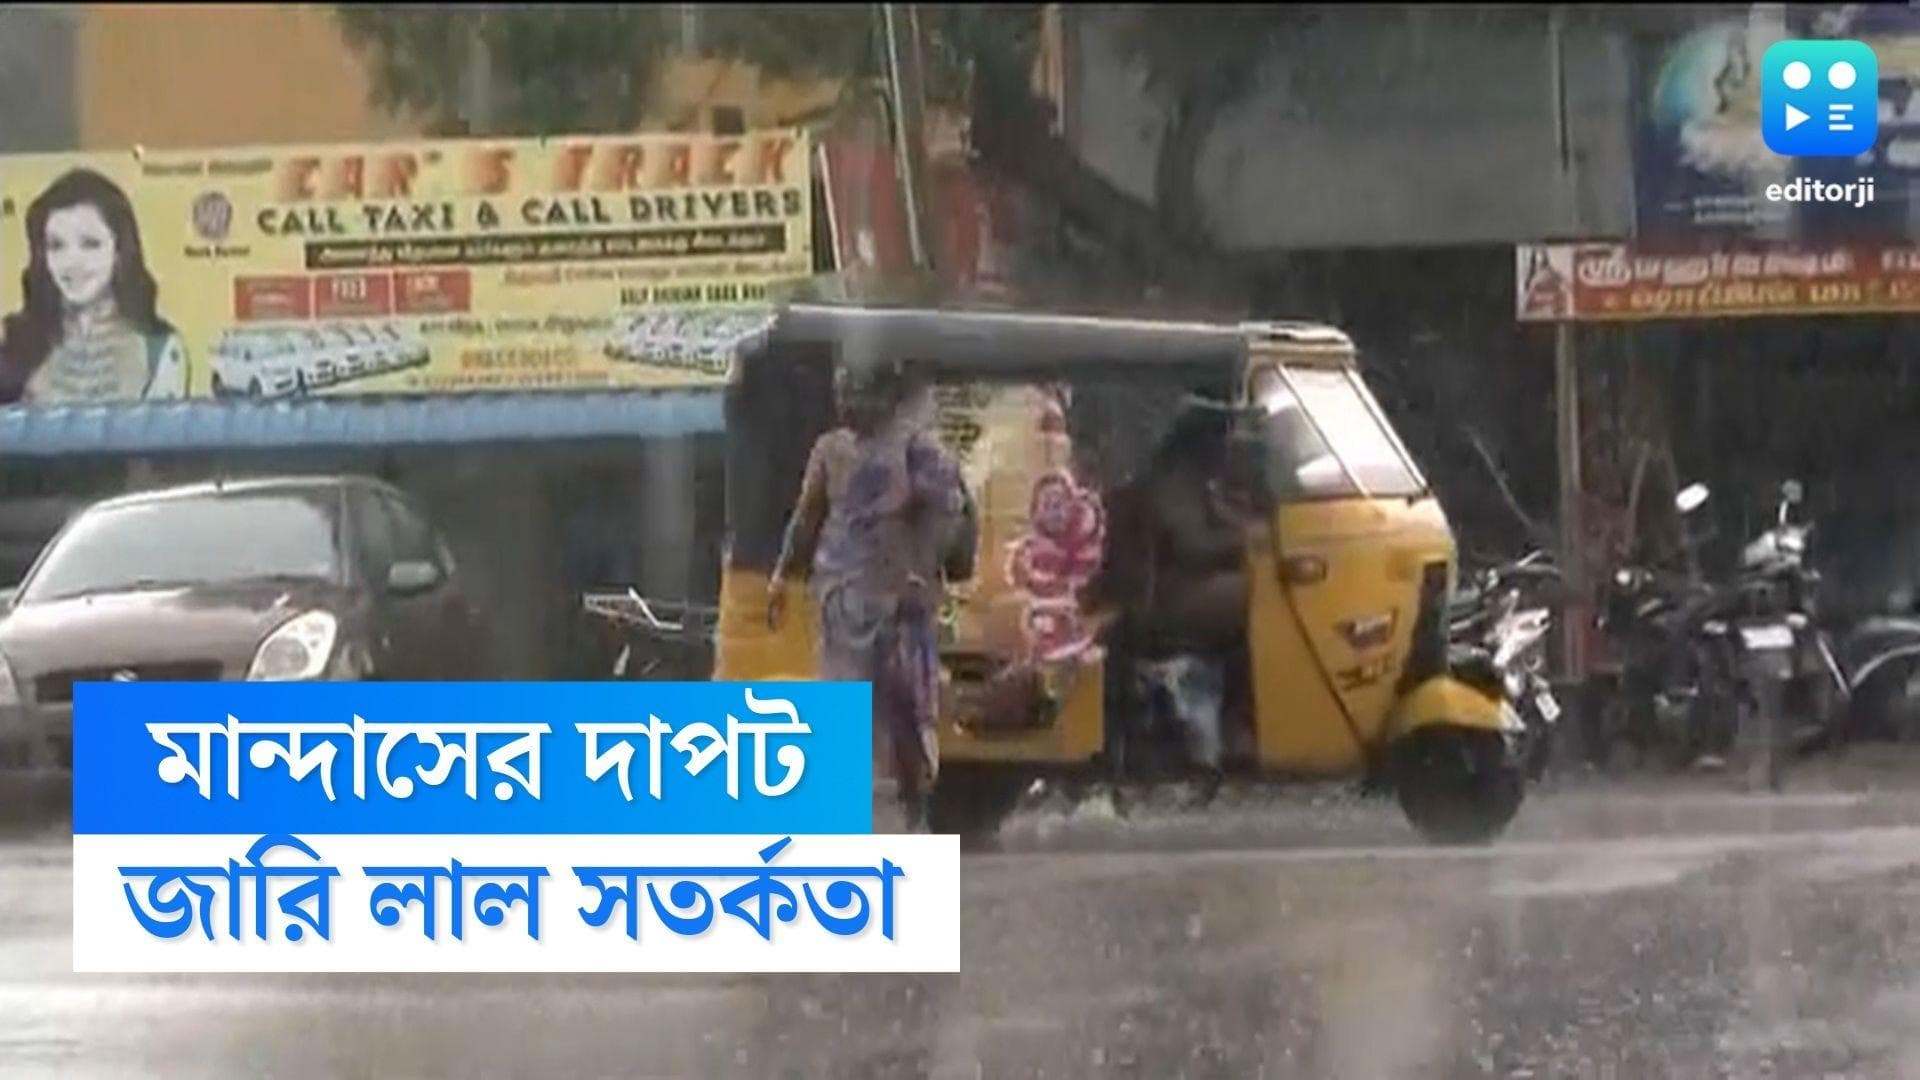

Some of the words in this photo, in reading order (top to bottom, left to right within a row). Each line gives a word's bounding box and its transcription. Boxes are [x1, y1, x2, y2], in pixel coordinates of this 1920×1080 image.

[549, 137, 793, 192] TRACK
[257, 204, 345, 236] CALL
[363, 202, 455, 234] TAXI
[476, 199, 499, 229] &
[521, 197, 612, 227] CALL
[630, 189, 801, 221] DRIVERS
